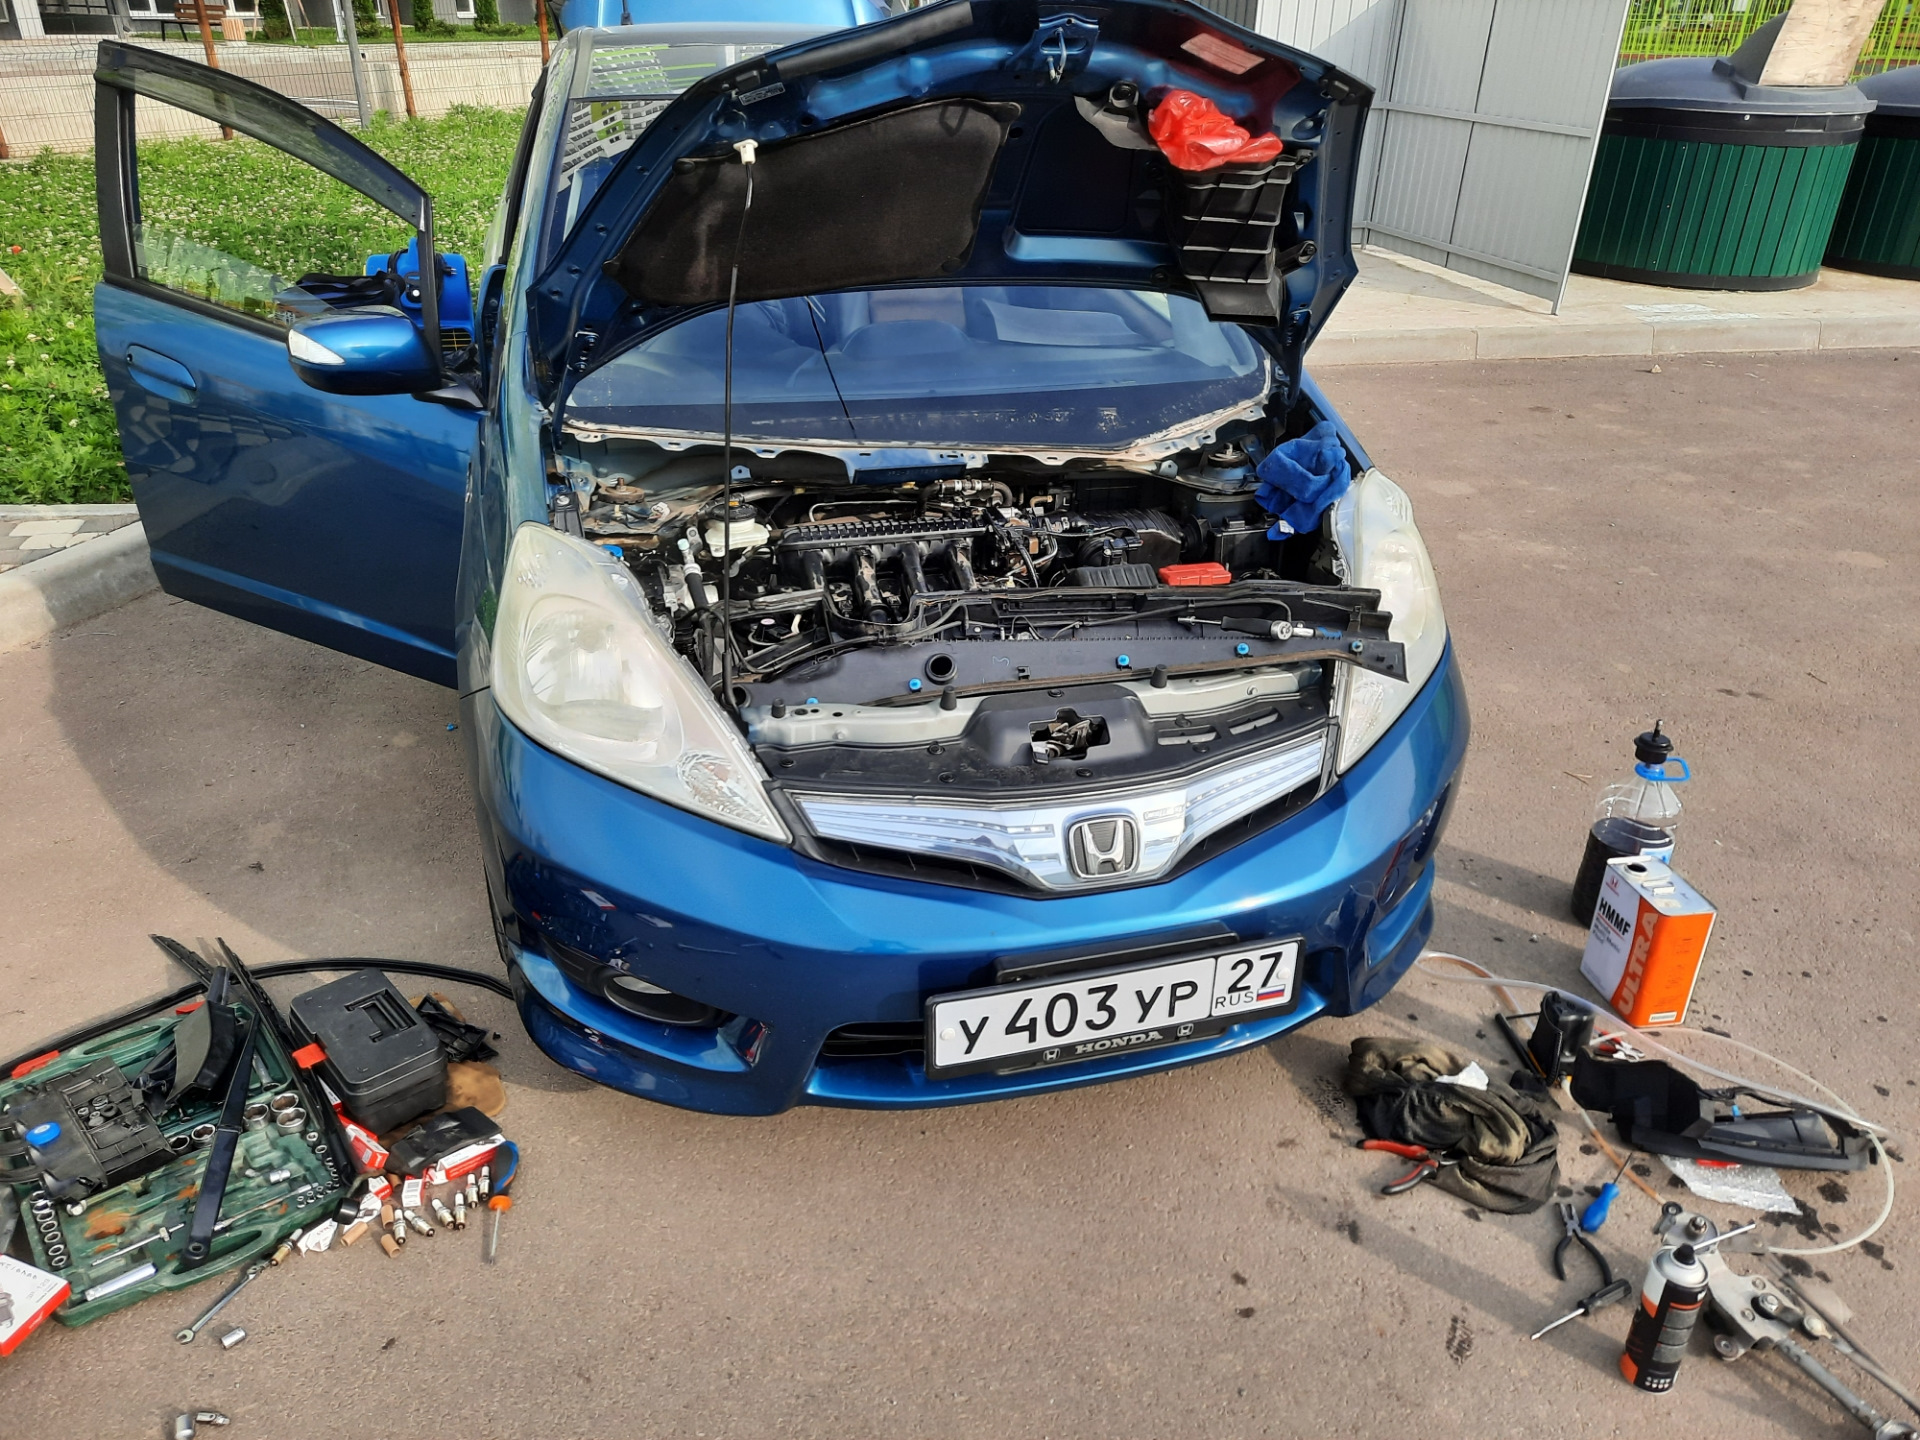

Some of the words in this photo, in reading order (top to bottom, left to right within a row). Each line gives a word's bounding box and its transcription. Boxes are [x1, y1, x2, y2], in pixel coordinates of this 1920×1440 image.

[1599, 897, 1631, 936] HMMF
[1618, 912, 1658, 1015] ULTRA
[1005, 984, 1118, 1043] 403
[1228, 952, 1283, 993] 27
[1215, 991, 1255, 1008] RUS
[1075, 1031, 1163, 1055] HONDA
